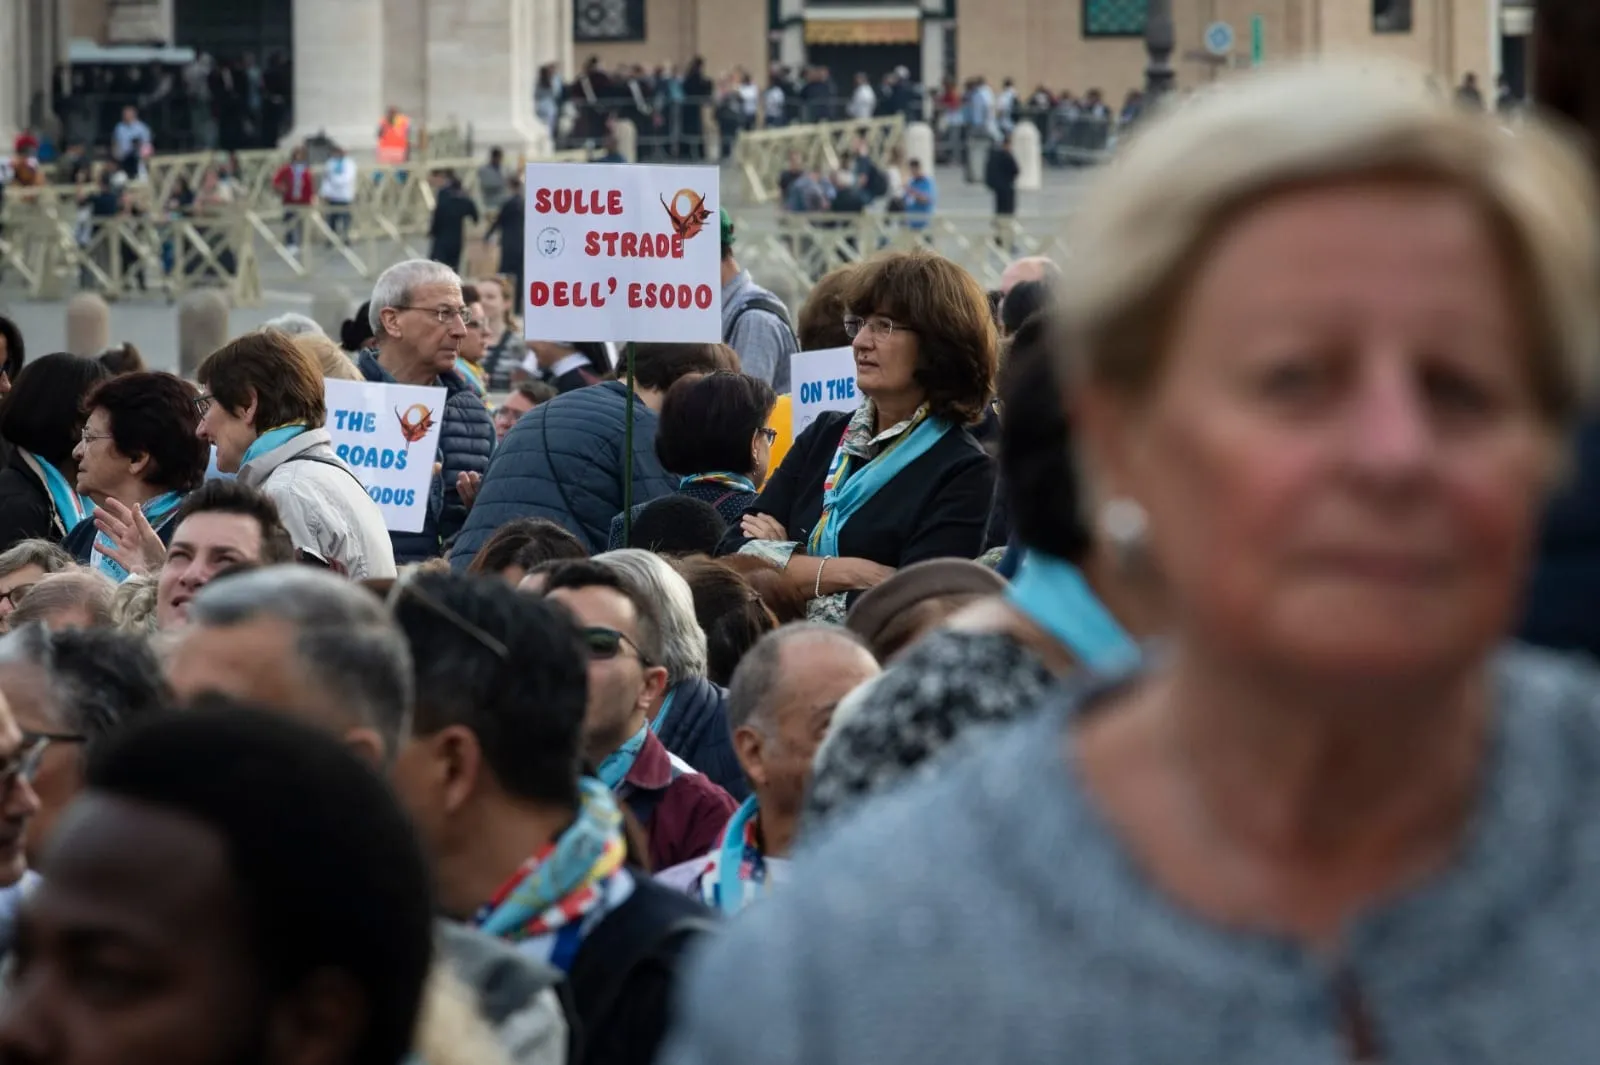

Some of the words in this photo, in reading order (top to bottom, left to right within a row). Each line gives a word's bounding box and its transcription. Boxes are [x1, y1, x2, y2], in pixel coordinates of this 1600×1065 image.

[535, 188, 623, 215] SULLE
[584, 231, 684, 259] STRADE
[628, 283, 712, 309] ESODO
[800, 381, 822, 404] ON
[827, 377, 855, 401] THE
[334, 410, 376, 433] THE
[336, 444, 408, 470] ROADS
[365, 485, 415, 507] ODUS
